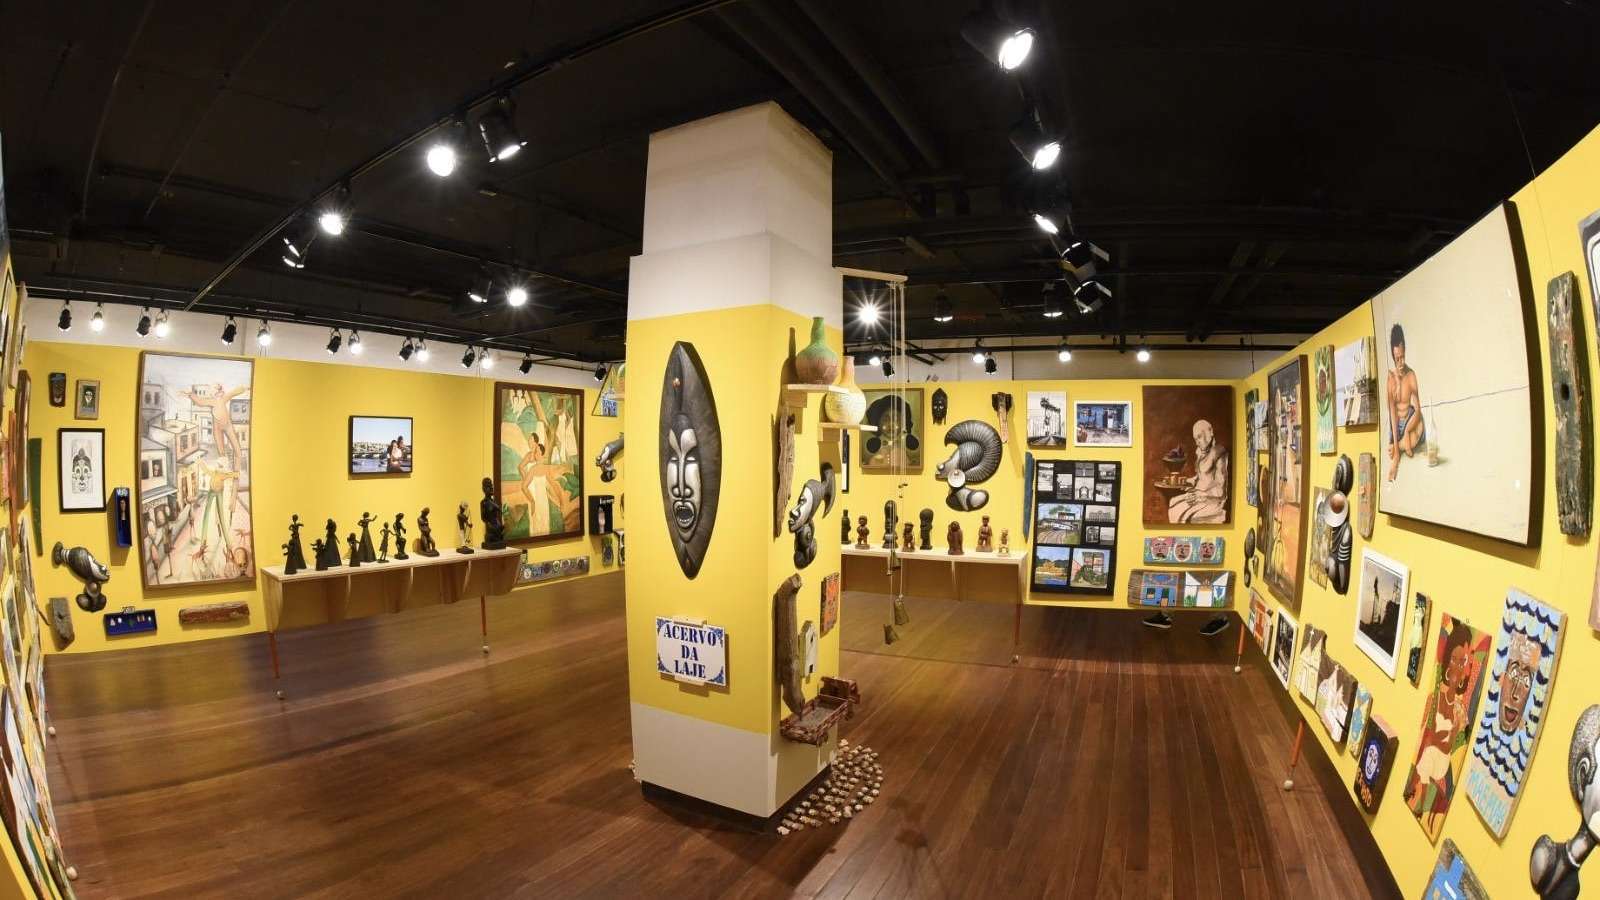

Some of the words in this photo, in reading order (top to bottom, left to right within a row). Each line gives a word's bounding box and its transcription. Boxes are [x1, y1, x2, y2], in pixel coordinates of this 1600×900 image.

[664, 624, 717, 646] ACERVO
[680, 645, 699, 661] DA
[674, 660, 706, 678] LAJE
